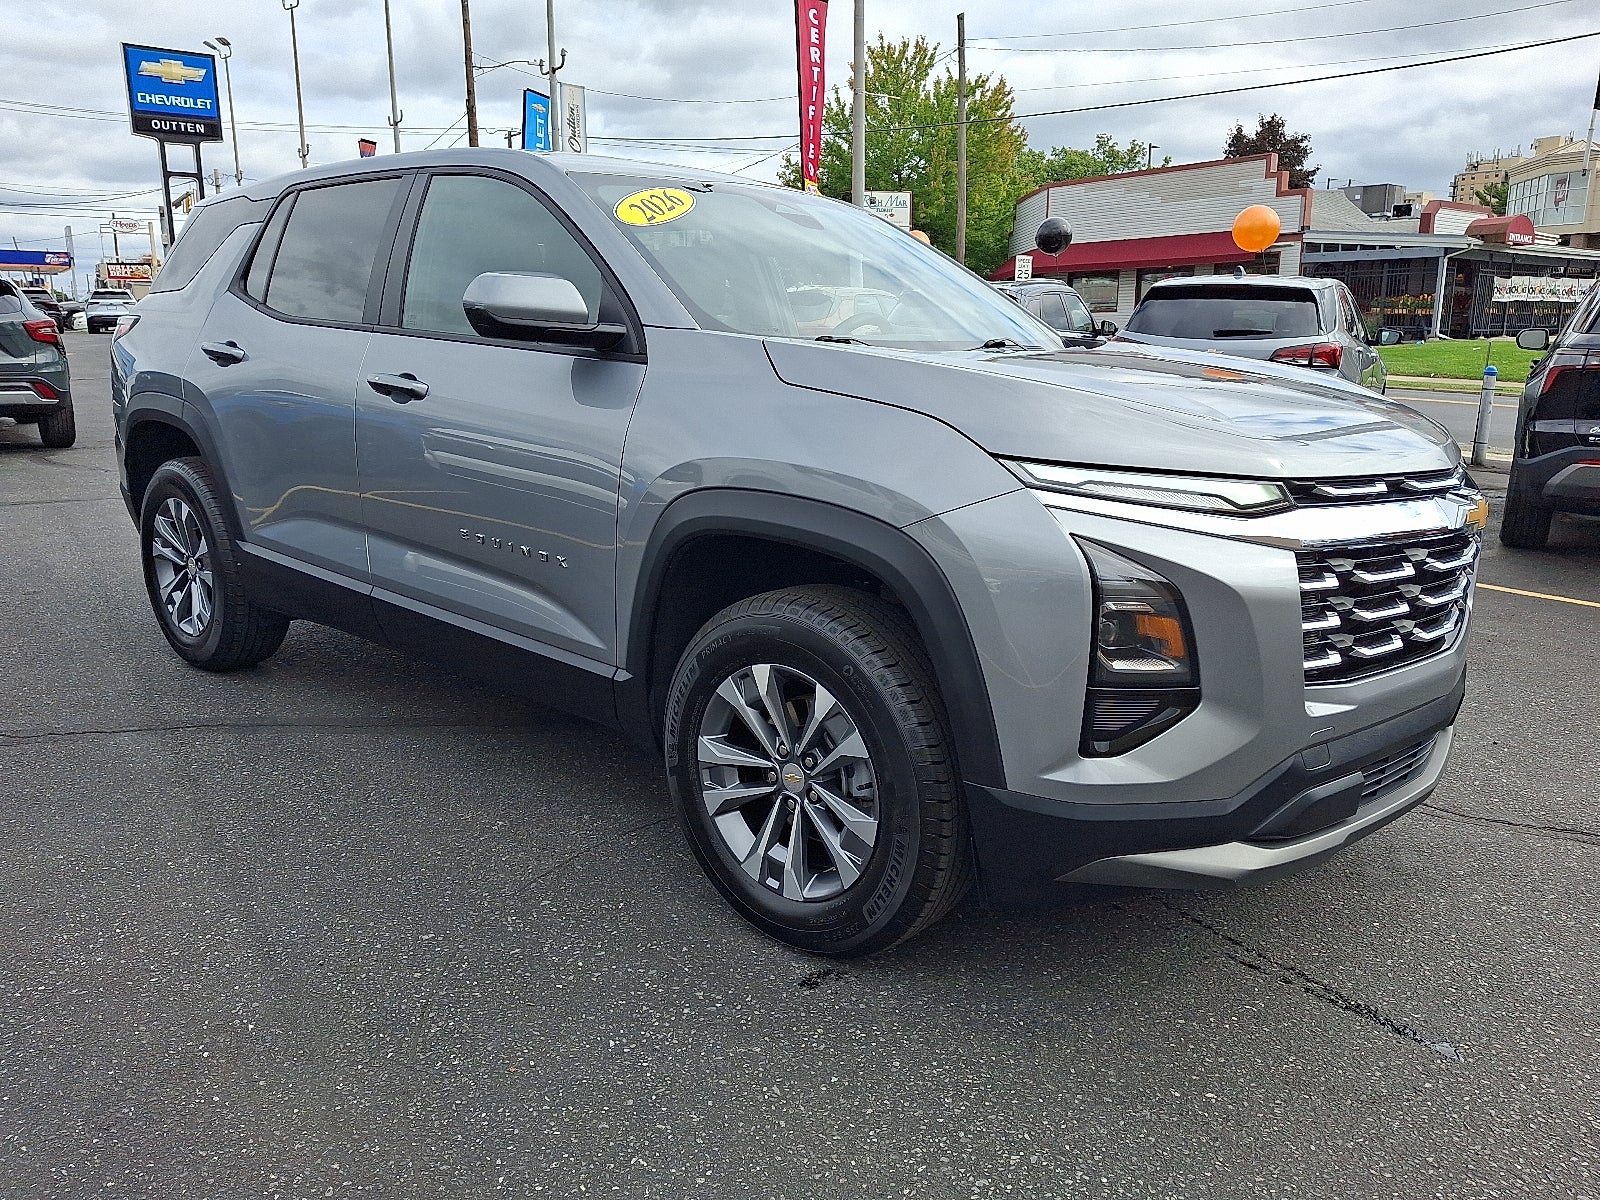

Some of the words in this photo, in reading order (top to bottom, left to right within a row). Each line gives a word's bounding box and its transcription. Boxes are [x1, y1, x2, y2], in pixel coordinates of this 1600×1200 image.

[137, 92, 213, 110] CHEVROLET
[808, 8, 821, 177] CERTIFIED
[151, 119, 205, 134] OUTTEN
[566, 103, 582, 153] Outten
[628, 190, 685, 222] 2026
[1508, 232, 1533, 244] ENTRANCE
[1016, 269, 1030, 280] 25
[459, 527, 569, 569] EQUINOX
[700, 633, 733, 659] PRIMACY
[667, 661, 697, 741] MICHELIN
[866, 837, 908, 921] MICHELIN
